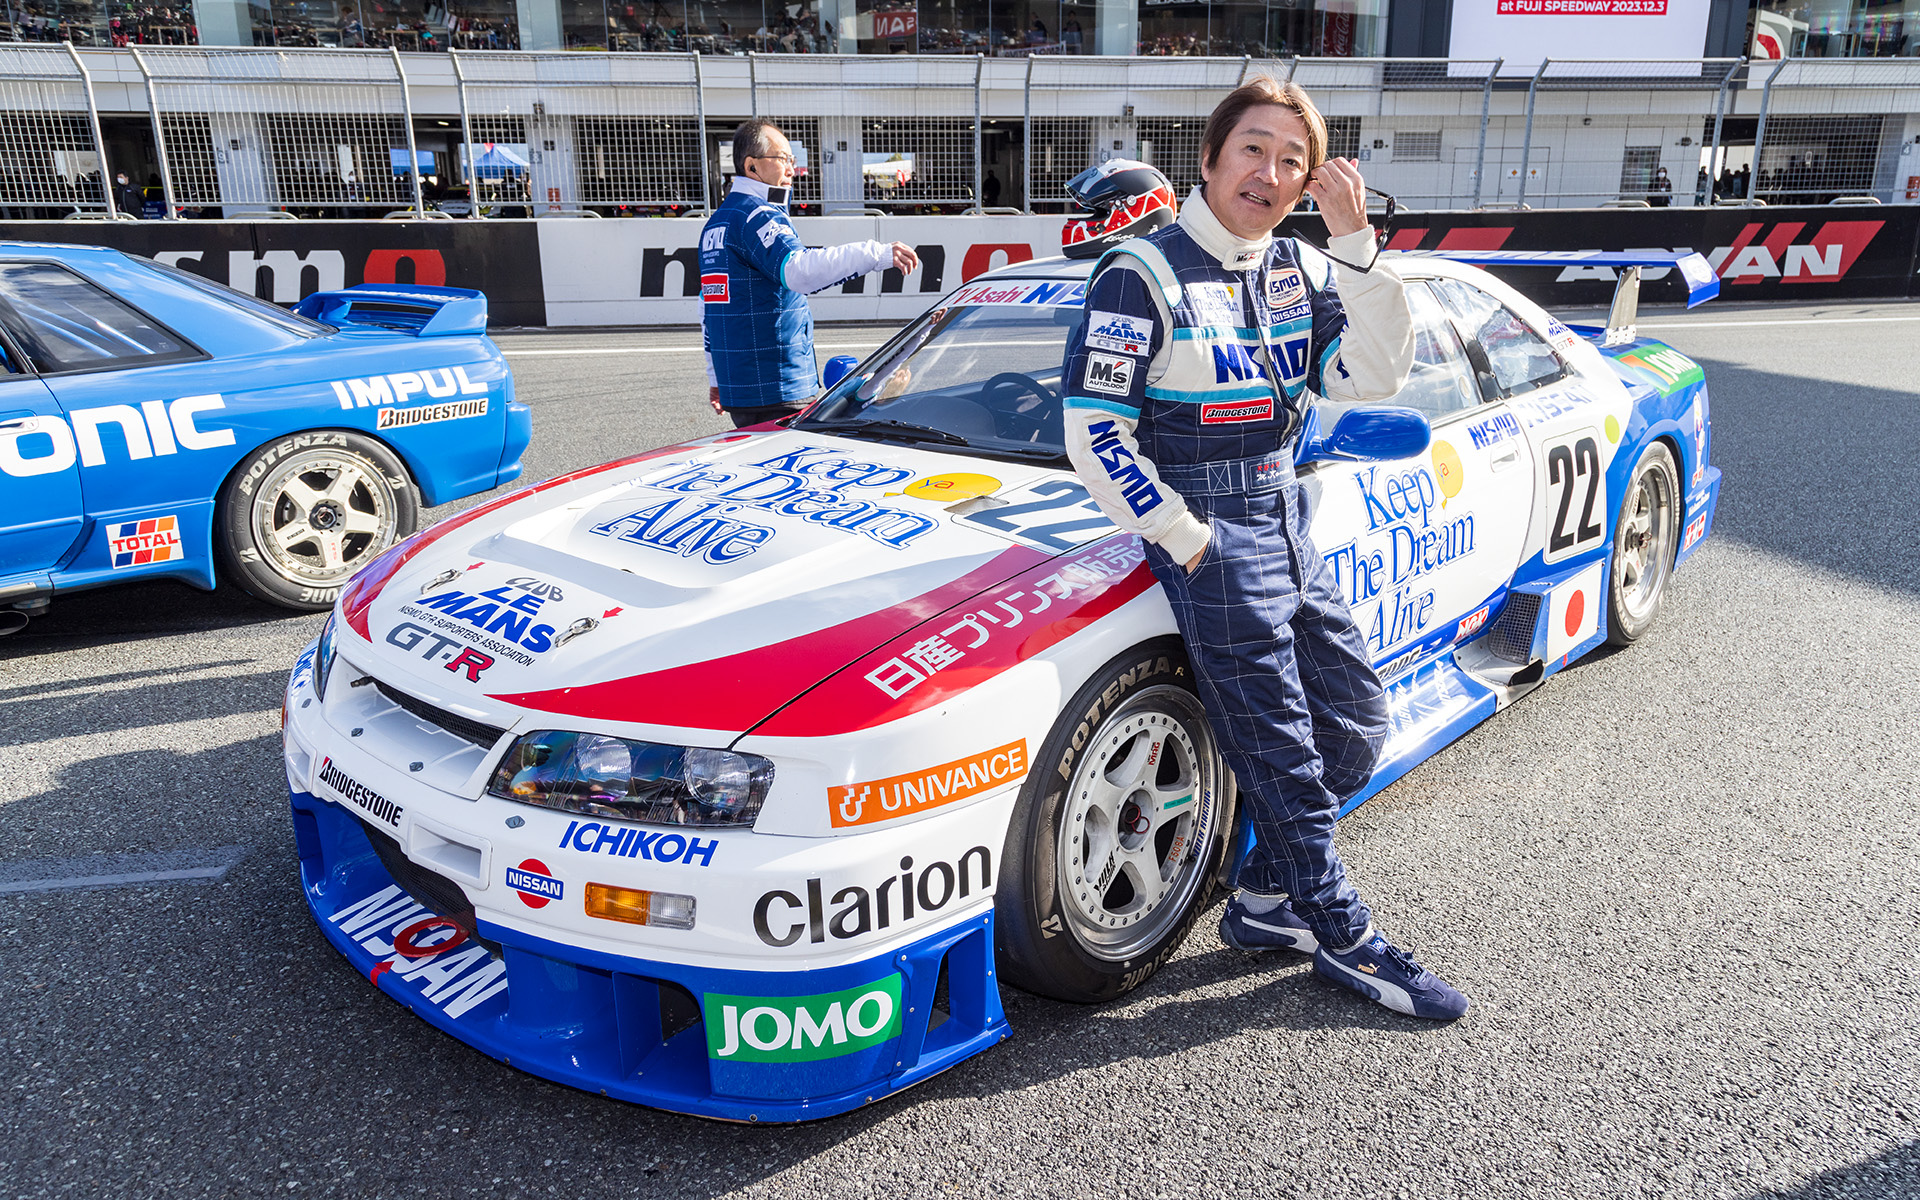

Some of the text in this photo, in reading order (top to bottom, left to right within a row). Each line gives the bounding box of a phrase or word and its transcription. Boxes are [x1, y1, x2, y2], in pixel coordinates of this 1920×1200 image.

[1500, 1, 1665, 12] at FUJI SPEEDWAY 2023.12.3
[965, 286, 1031, 304] Asahi
[1272, 304, 1310, 323] NISSAN
[1094, 325, 1148, 342] MANS
[1109, 321, 1133, 330] LE
[330, 366, 489, 410] IMPUL
[1089, 380, 1126, 390] AUTOLOOK
[1644, 349, 1698, 382] JOMO
[380, 400, 487, 428] BRIDGESTONE
[1205, 404, 1271, 419] BRIDGESTONE
[1466, 412, 1521, 451] NISMO
[238, 432, 348, 496] POTENZA
[744, 445, 913, 493] Keep
[1088, 420, 1164, 519] NISMO
[714, 471, 938, 548] Dream
[964, 480, 1118, 551] 22
[1354, 464, 1435, 531] Keep
[1548, 436, 1602, 554] 22
[112, 531, 179, 553] TOTAL
[592, 496, 774, 564] Alive
[1323, 515, 1475, 604] The Dream
[478, 586, 545, 616] LE
[505, 576, 564, 602] CLUB
[398, 604, 422, 622] NISMO
[434, 618, 484, 644] SUPPORTERS
[479, 637, 536, 668] ASSOCIATION
[415, 590, 556, 654] MANS
[1366, 586, 1434, 653] Alive
[385, 621, 496, 684] GT-R
[1057, 656, 1171, 781] POTENZA
[318, 756, 404, 828] BRIDGESTONE
[880, 748, 1024, 811] UNIVANCE
[560, 820, 720, 866] ICHIKOH
[1168, 836, 1185, 862] F508A
[508, 870, 562, 896] NISSAN
[753, 846, 992, 948] Clarion
[717, 990, 893, 1058] JOMO
